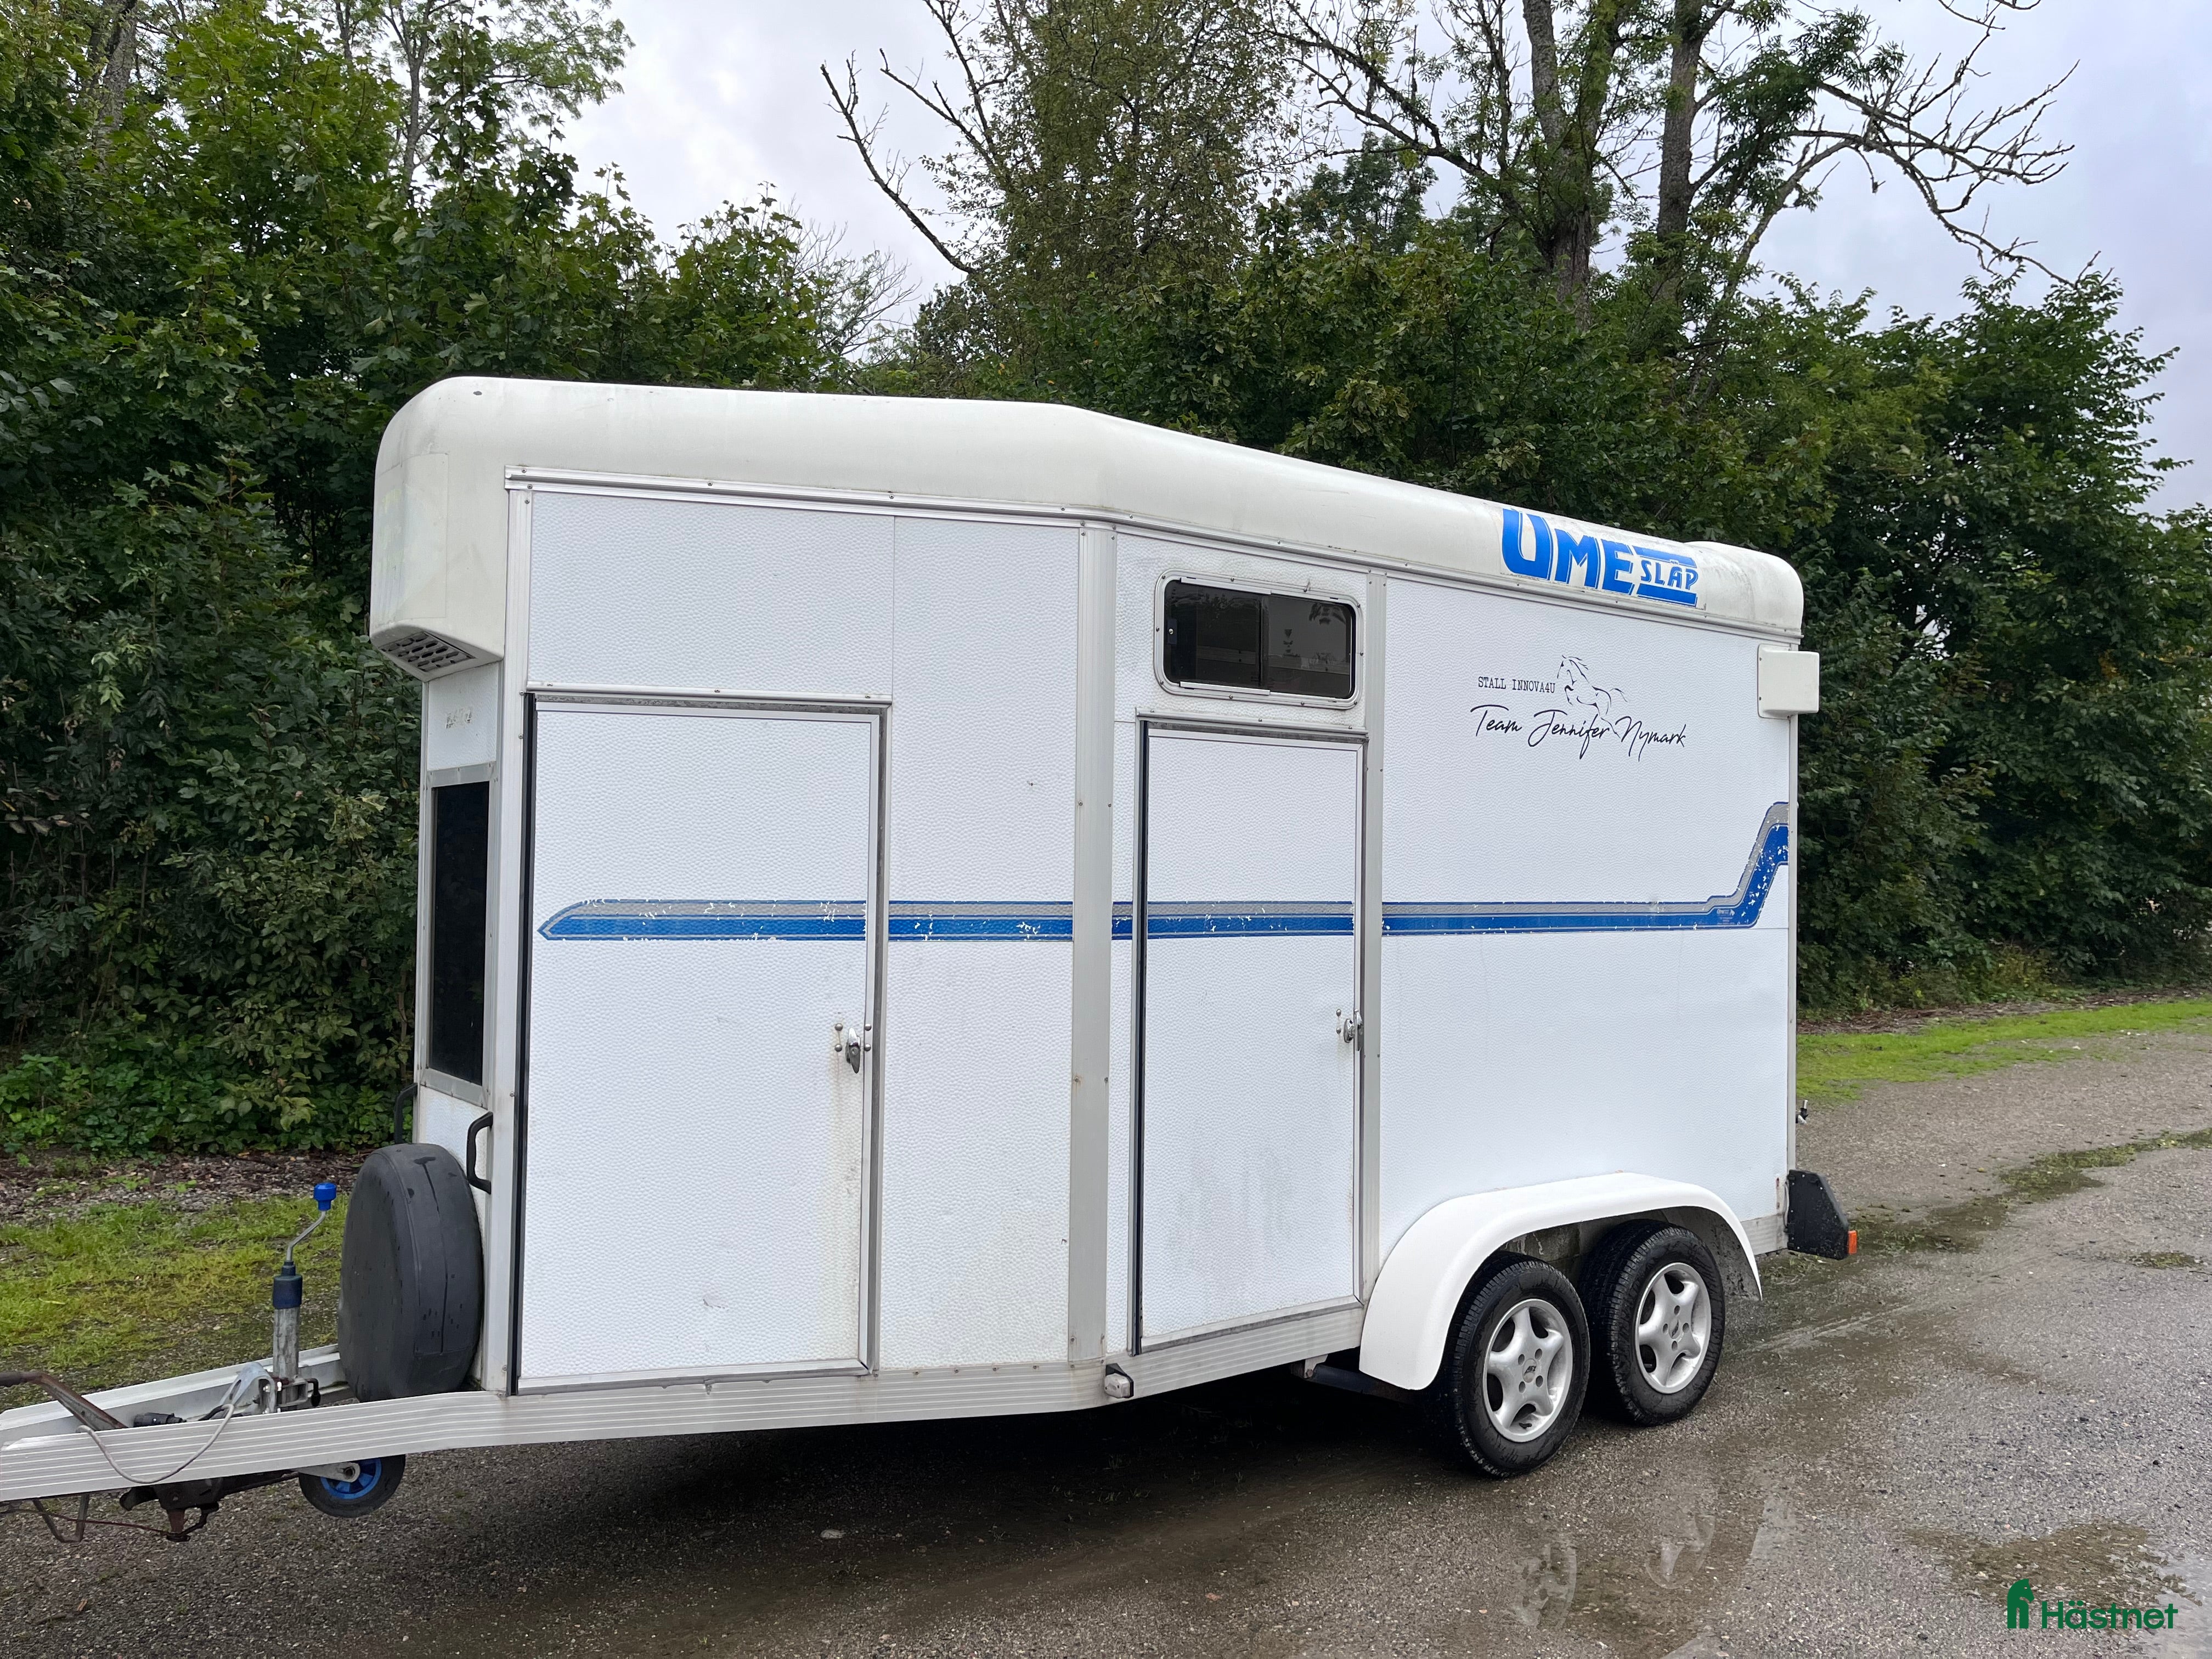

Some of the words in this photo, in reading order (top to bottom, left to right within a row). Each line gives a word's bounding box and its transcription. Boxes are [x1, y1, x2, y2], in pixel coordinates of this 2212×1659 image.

[1502, 508, 1635, 596] UME
[1478, 676, 1506, 690] STALL
[1512, 679, 1556, 693] INNOVA4U
[1470, 704, 1523, 737] Team
[1527, 709, 1610, 760] Jennifer
[1615, 715, 1687, 763] Nymark
